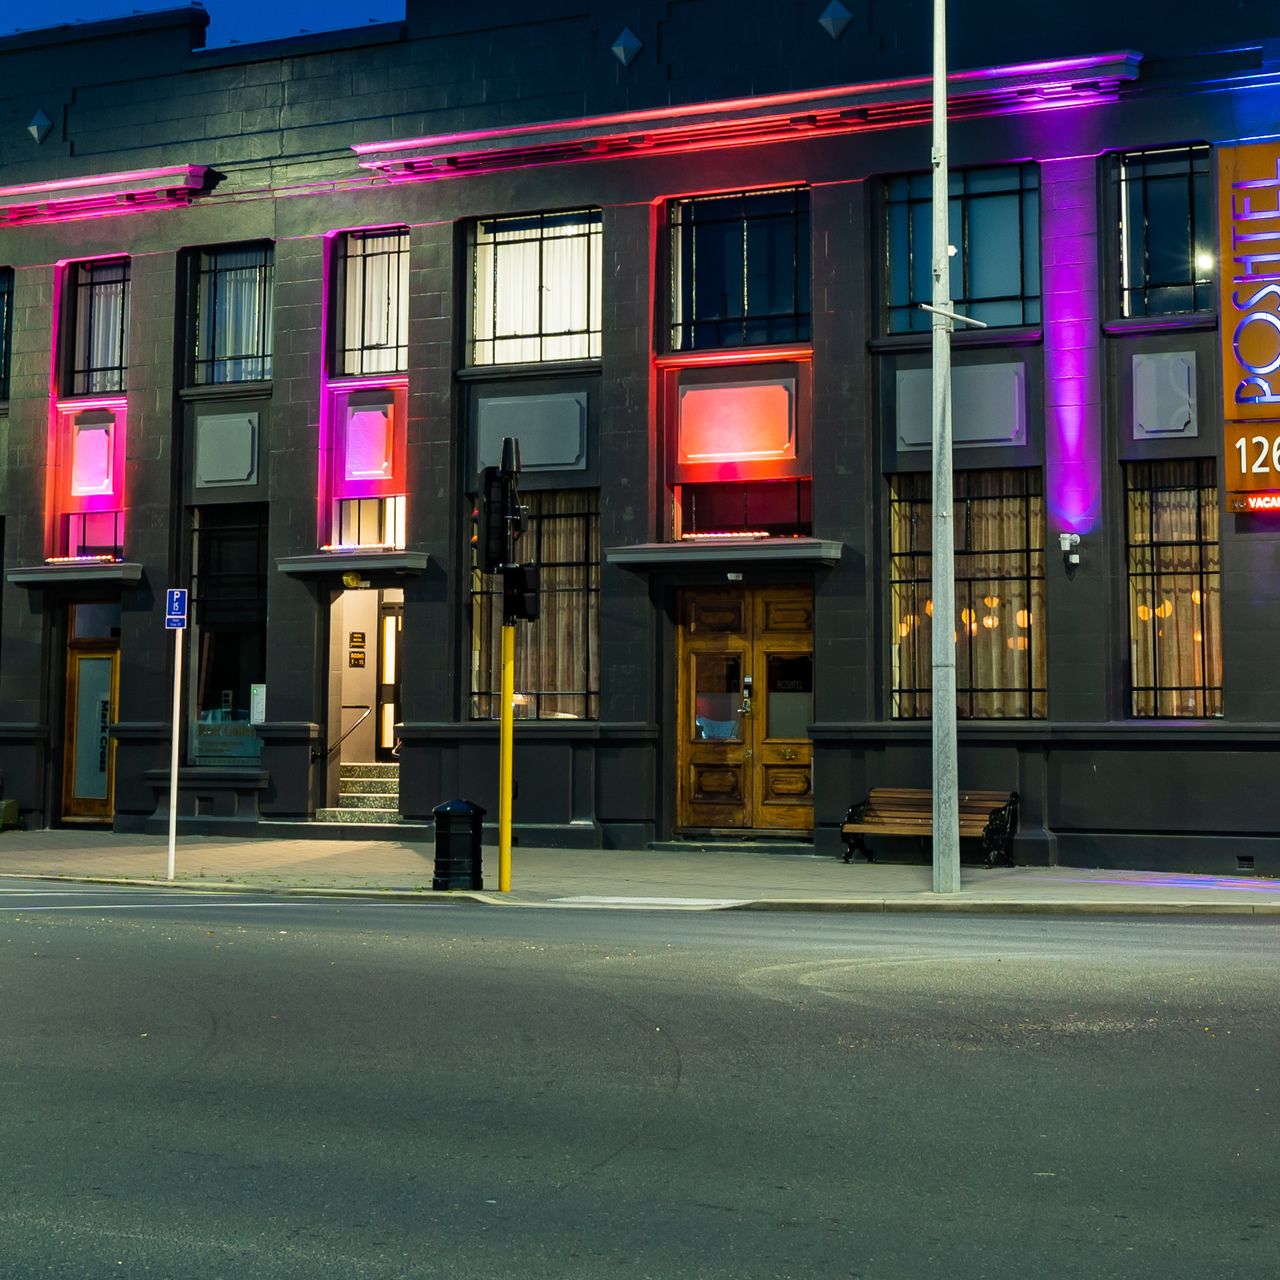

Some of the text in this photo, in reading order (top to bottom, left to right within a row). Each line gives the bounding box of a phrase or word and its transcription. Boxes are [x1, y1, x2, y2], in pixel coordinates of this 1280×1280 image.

[173, 591, 180, 601] P
[99, 700, 109, 773] Mark Cross
